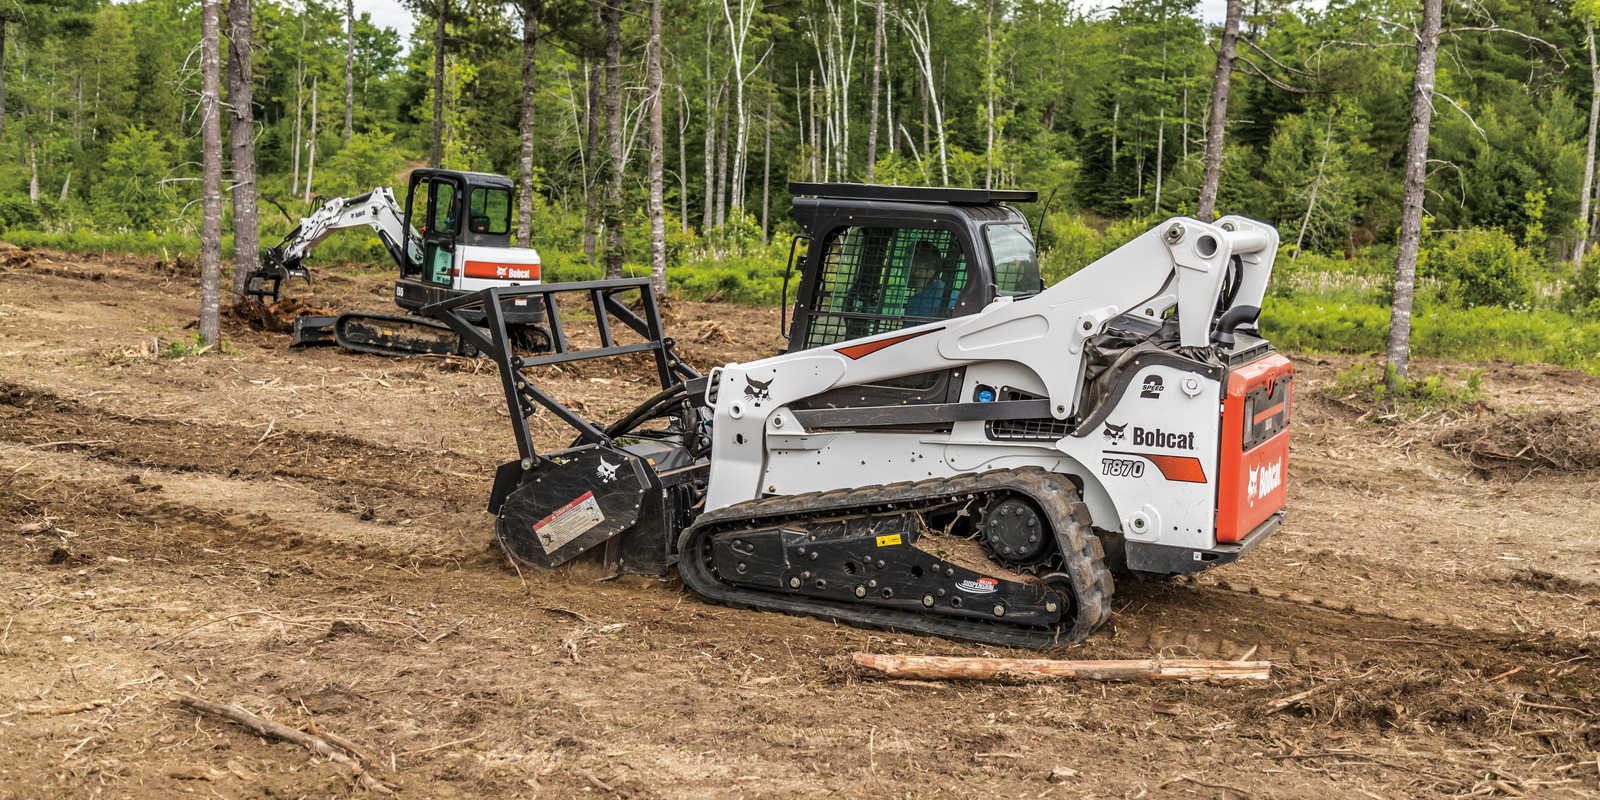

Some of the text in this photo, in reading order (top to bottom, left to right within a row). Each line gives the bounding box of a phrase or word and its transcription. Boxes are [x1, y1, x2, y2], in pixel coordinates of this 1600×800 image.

[508, 268, 530, 279] Bobcat
[1140, 374, 1163, 399] 2
[1132, 426, 1195, 451] Bobcat
[1102, 458, 1145, 478] T870
[1258, 456, 1282, 499] Bobcat
[555, 503, 574, 517] DANGER
